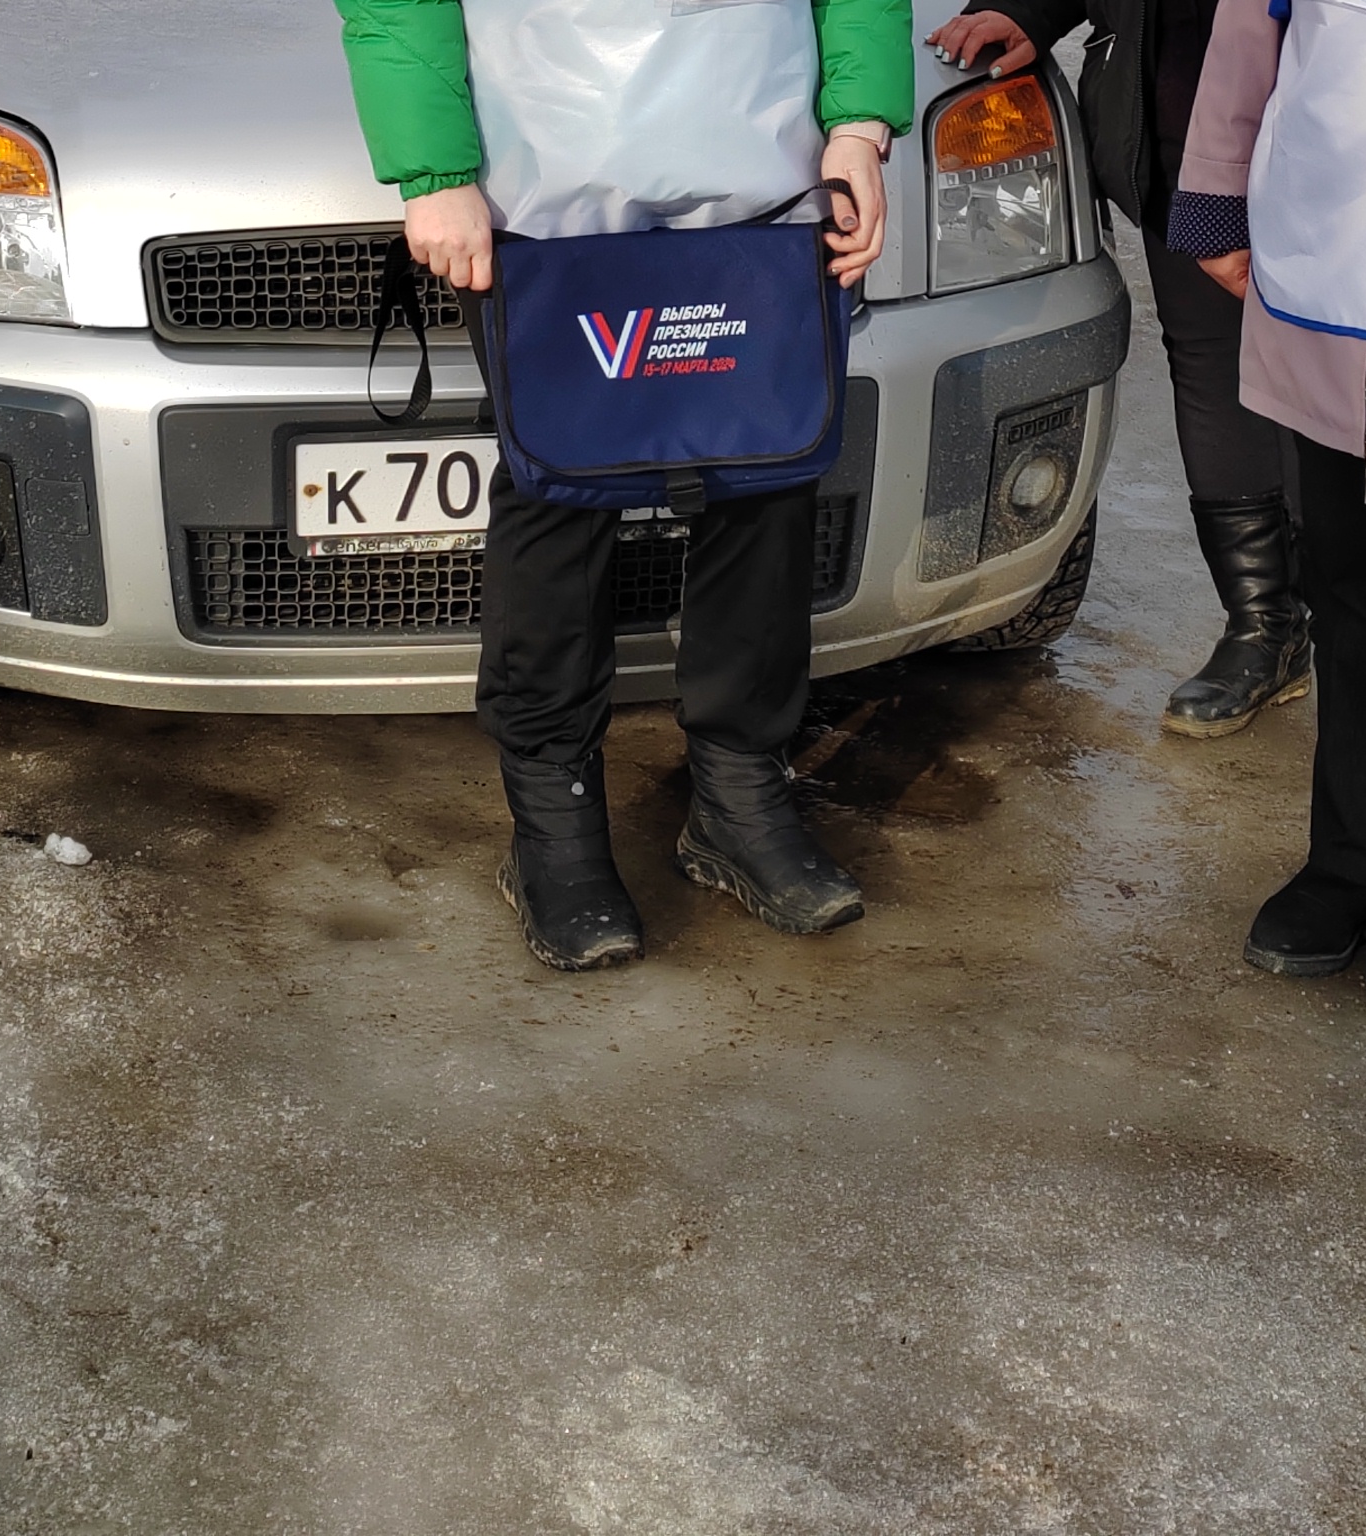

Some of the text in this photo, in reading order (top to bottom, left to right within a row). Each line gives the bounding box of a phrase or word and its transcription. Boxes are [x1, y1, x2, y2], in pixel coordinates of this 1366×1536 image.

[659, 303, 727, 322] ВЫБОРЫ
[652, 320, 747, 341] ПРЕЗИДЕНТА
[646, 341, 708, 360] РОССИИ
[672, 358, 709, 374] МАРТА
